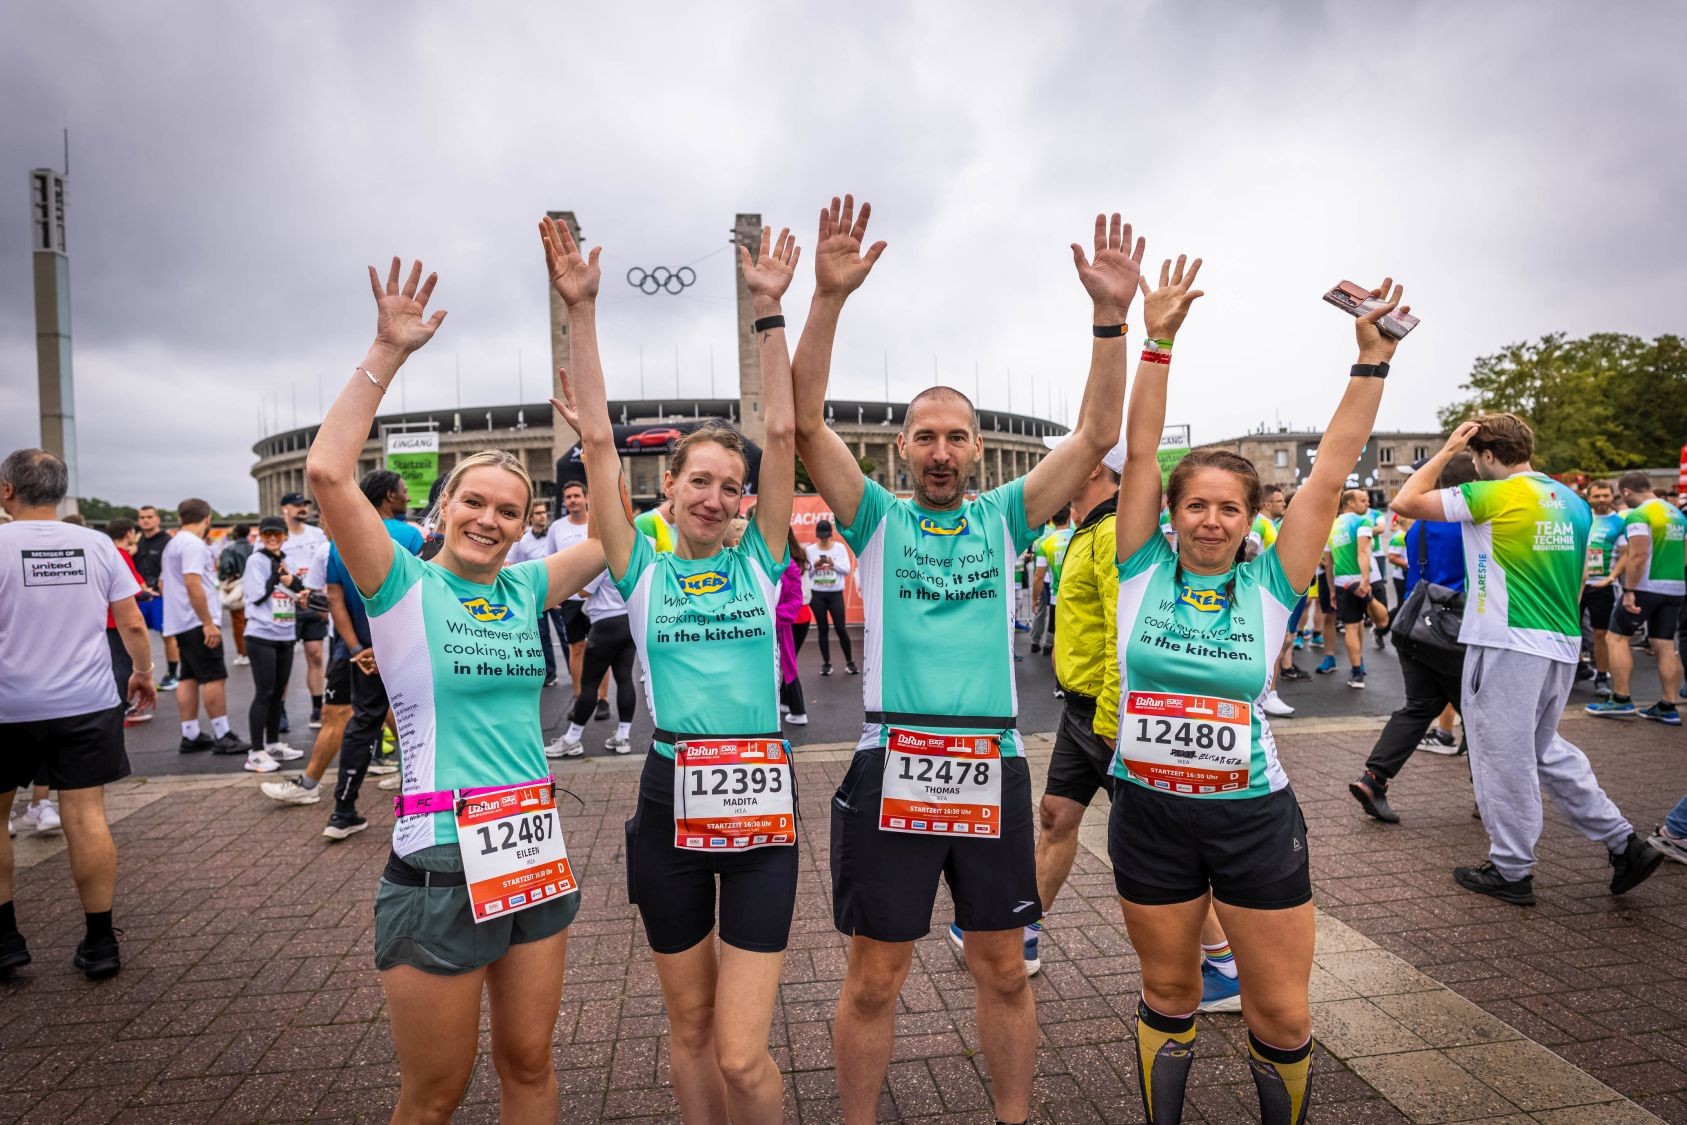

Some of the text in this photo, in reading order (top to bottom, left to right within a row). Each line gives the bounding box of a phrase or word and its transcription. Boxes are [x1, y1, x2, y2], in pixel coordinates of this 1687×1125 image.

[392, 437, 433, 449] EINGANG
[393, 459, 433, 469] Startzeit
[1538, 499, 1567, 509] SPIE
[1535, 520, 1574, 535] TEAM
[1533, 535, 1575, 545] TECHNIK
[31, 561, 72, 570] united
[32, 569, 85, 577] internet
[952, 573, 963, 585] it
[968, 567, 999, 582] starts
[679, 577, 724, 590] IKEA
[899, 586, 997, 601] in the kitchen.
[655, 610, 711, 626] cooking,
[731, 606, 766, 620] starts
[446, 619, 512, 640] Whatever
[657, 626, 766, 643] in the kitchen.
[443, 642, 511, 660] cooking,
[513, 646, 523, 658] it
[1140, 631, 1252, 661] in the kitchen.
[454, 661, 471, 674] in
[477, 662, 503, 676] the
[1135, 696, 1164, 707] B2Run
[897, 733, 926, 747] B2Run
[1136, 718, 1237, 752] 12480
[687, 745, 718, 757] B2Run
[898, 756, 990, 786] 12478
[1150, 767, 1184, 777] STARTZEIT
[1186, 771, 1205, 779] 16:30
[1229, 771, 1239, 780] D
[691, 767, 783, 796] 12393
[924, 785, 960, 794] THOMAS
[723, 797, 758, 807] MADITA
[910, 805, 943, 815] STARTZEIT
[982, 808, 991, 818] D
[706, 822, 743, 830] STARTZEIT
[743, 820, 761, 828] 16:30
[780, 817, 787, 828] D
[476, 812, 553, 856] 12487
[516, 846, 540, 859] EILEEN
[502, 873, 535, 888] STARTZEIT
[557, 862, 565, 874] D
